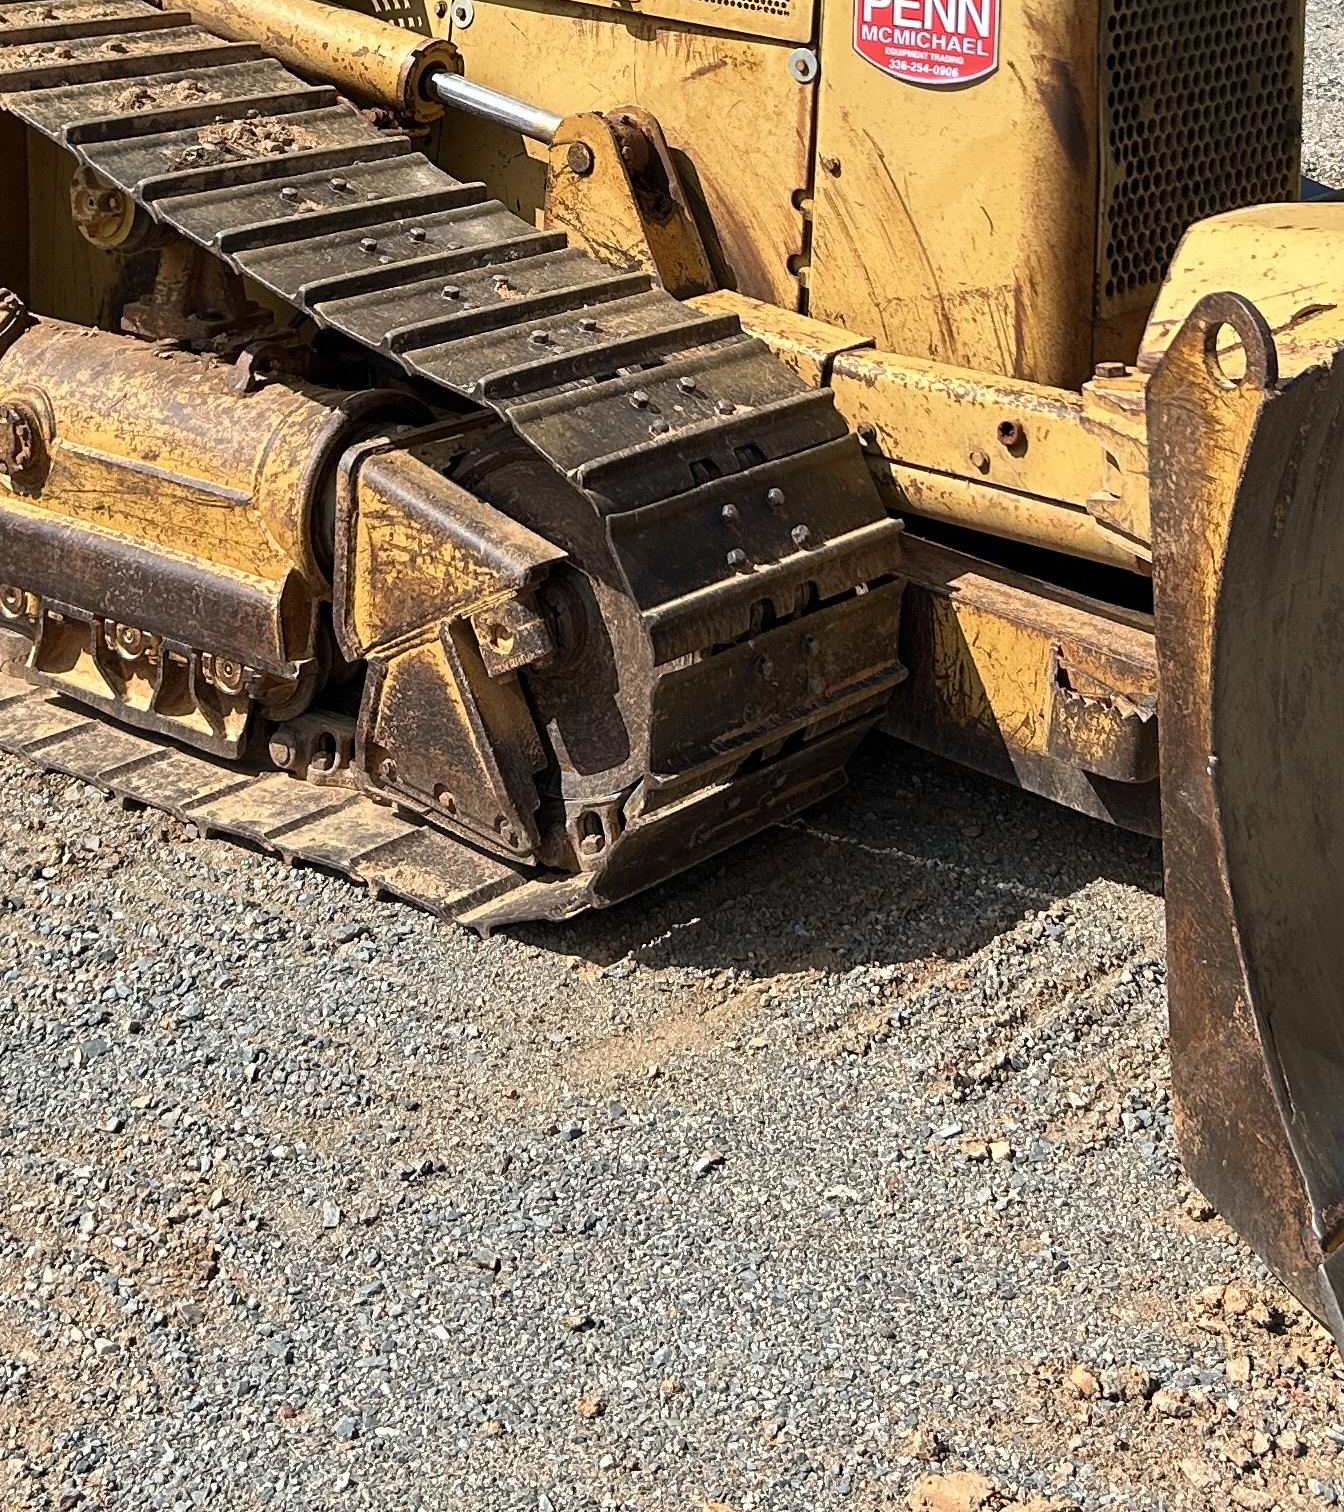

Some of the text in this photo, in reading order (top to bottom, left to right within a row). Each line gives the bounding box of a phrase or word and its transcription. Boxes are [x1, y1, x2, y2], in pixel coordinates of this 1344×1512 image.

[861, 24, 990, 57] MCMICHAEL
[884, 46, 965, 65] EQUIPMENT TRADING
